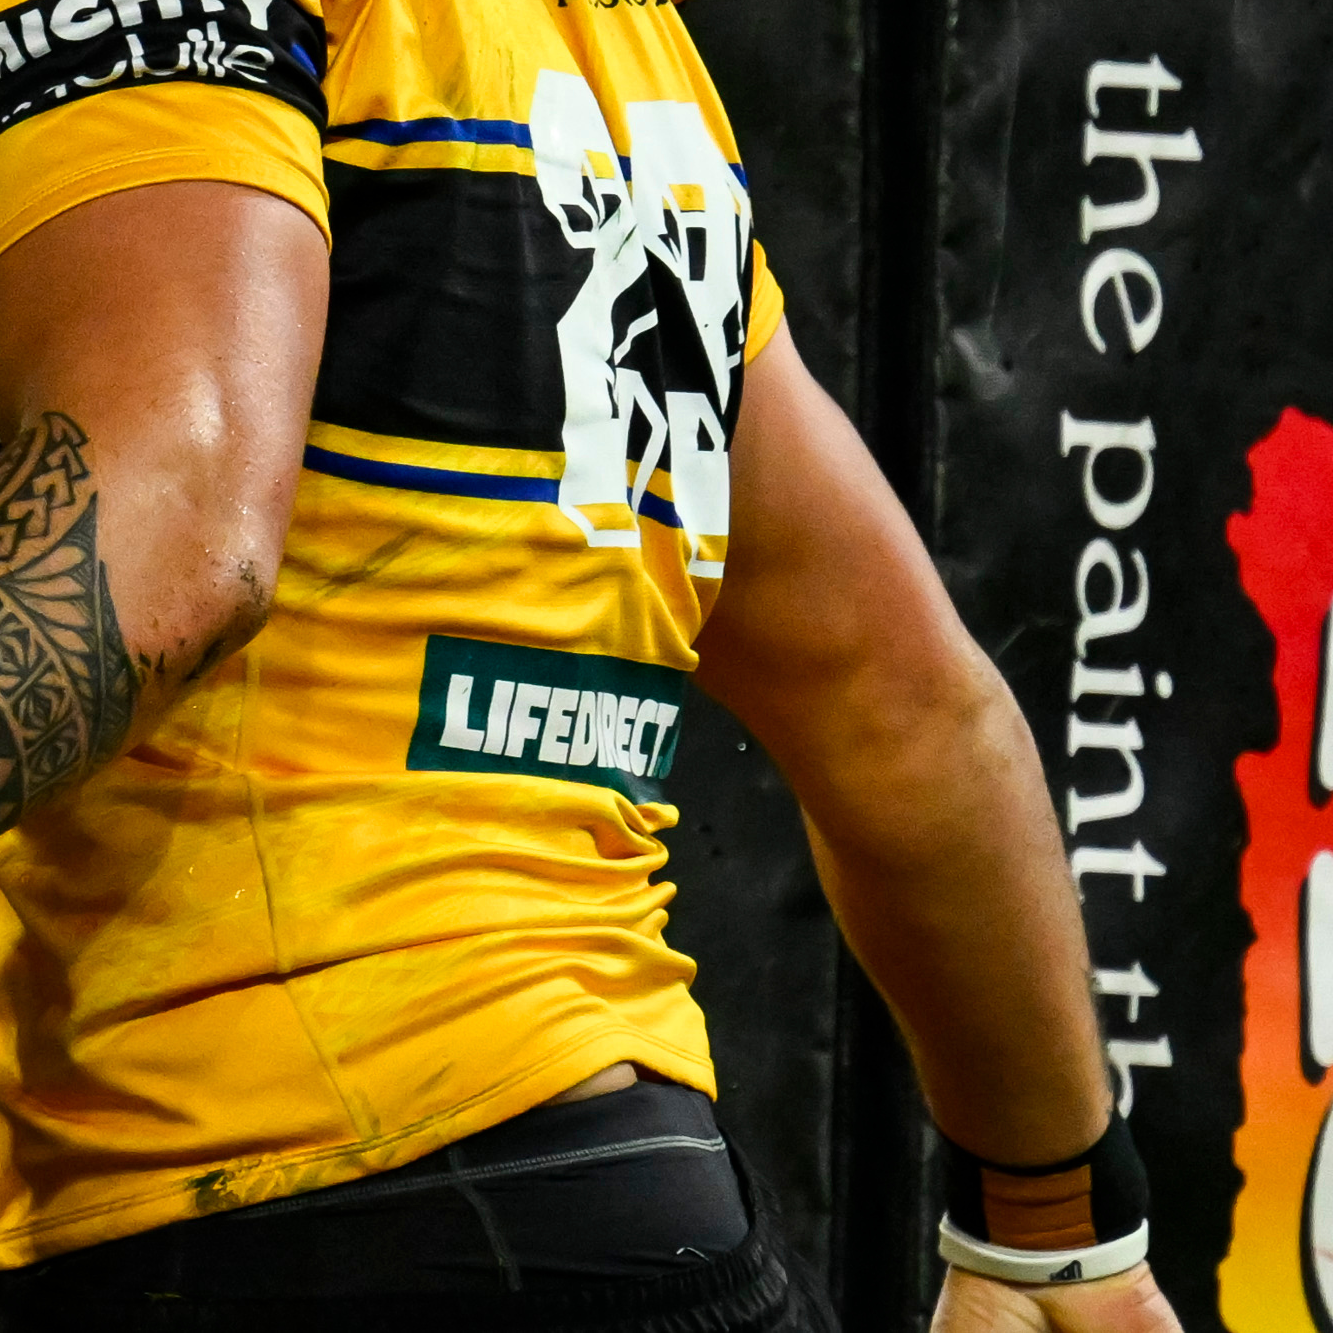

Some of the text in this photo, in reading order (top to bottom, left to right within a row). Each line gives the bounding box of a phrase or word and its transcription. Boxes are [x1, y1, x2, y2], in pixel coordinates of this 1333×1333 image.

[1080, 53, 1203, 354] the
[439, 673, 680, 778] LIFEDIRECT
[1060, 409, 1173, 904] paint
